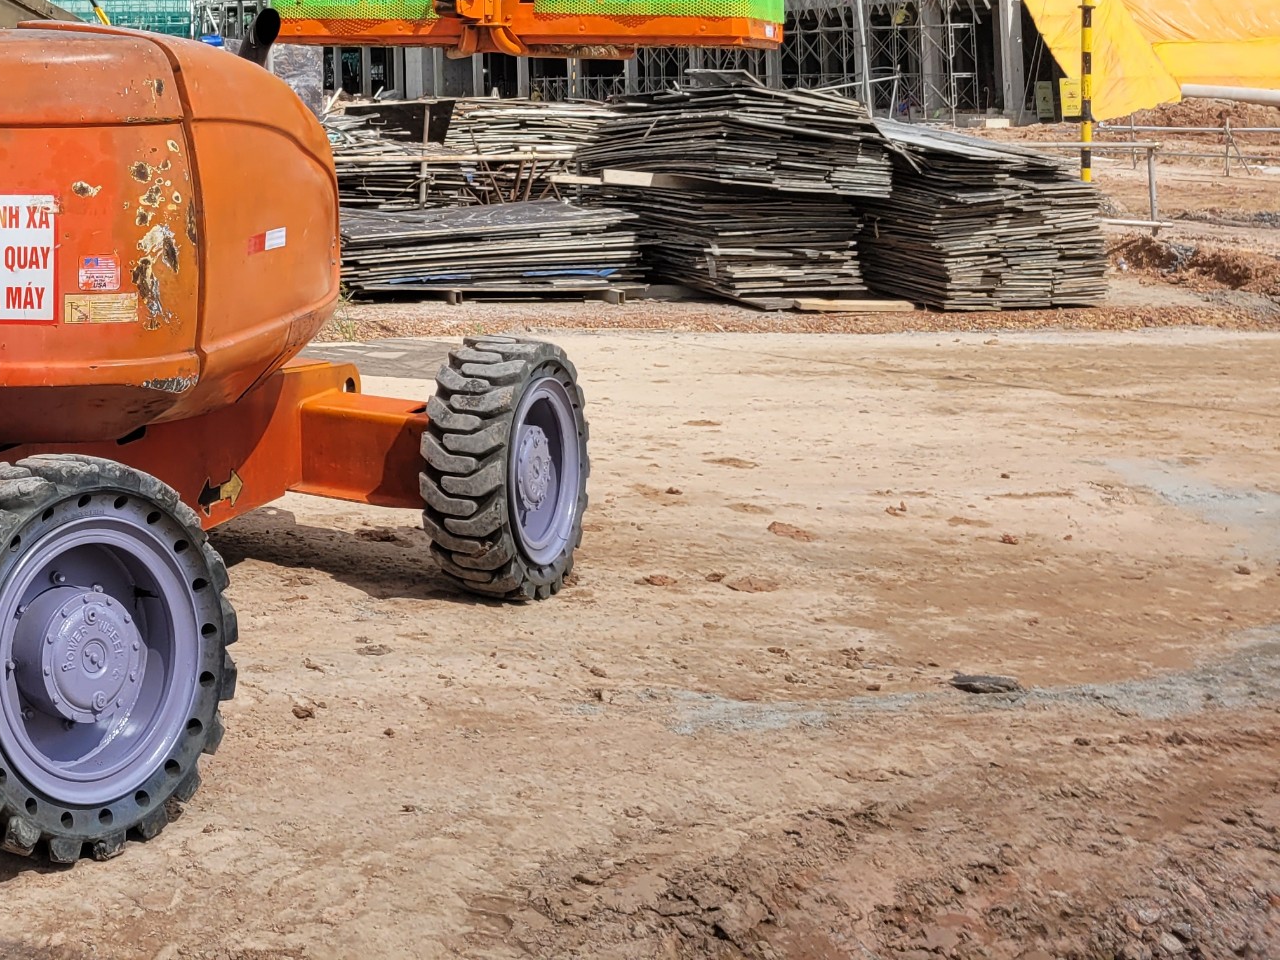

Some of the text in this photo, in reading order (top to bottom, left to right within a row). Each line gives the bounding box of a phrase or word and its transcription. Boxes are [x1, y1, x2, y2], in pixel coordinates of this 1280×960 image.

[26, 205, 50, 230] XA
[5, 246, 50, 272] QUAY
[6, 282, 46, 310] MÁY
[62, 625, 88, 672] POWER
